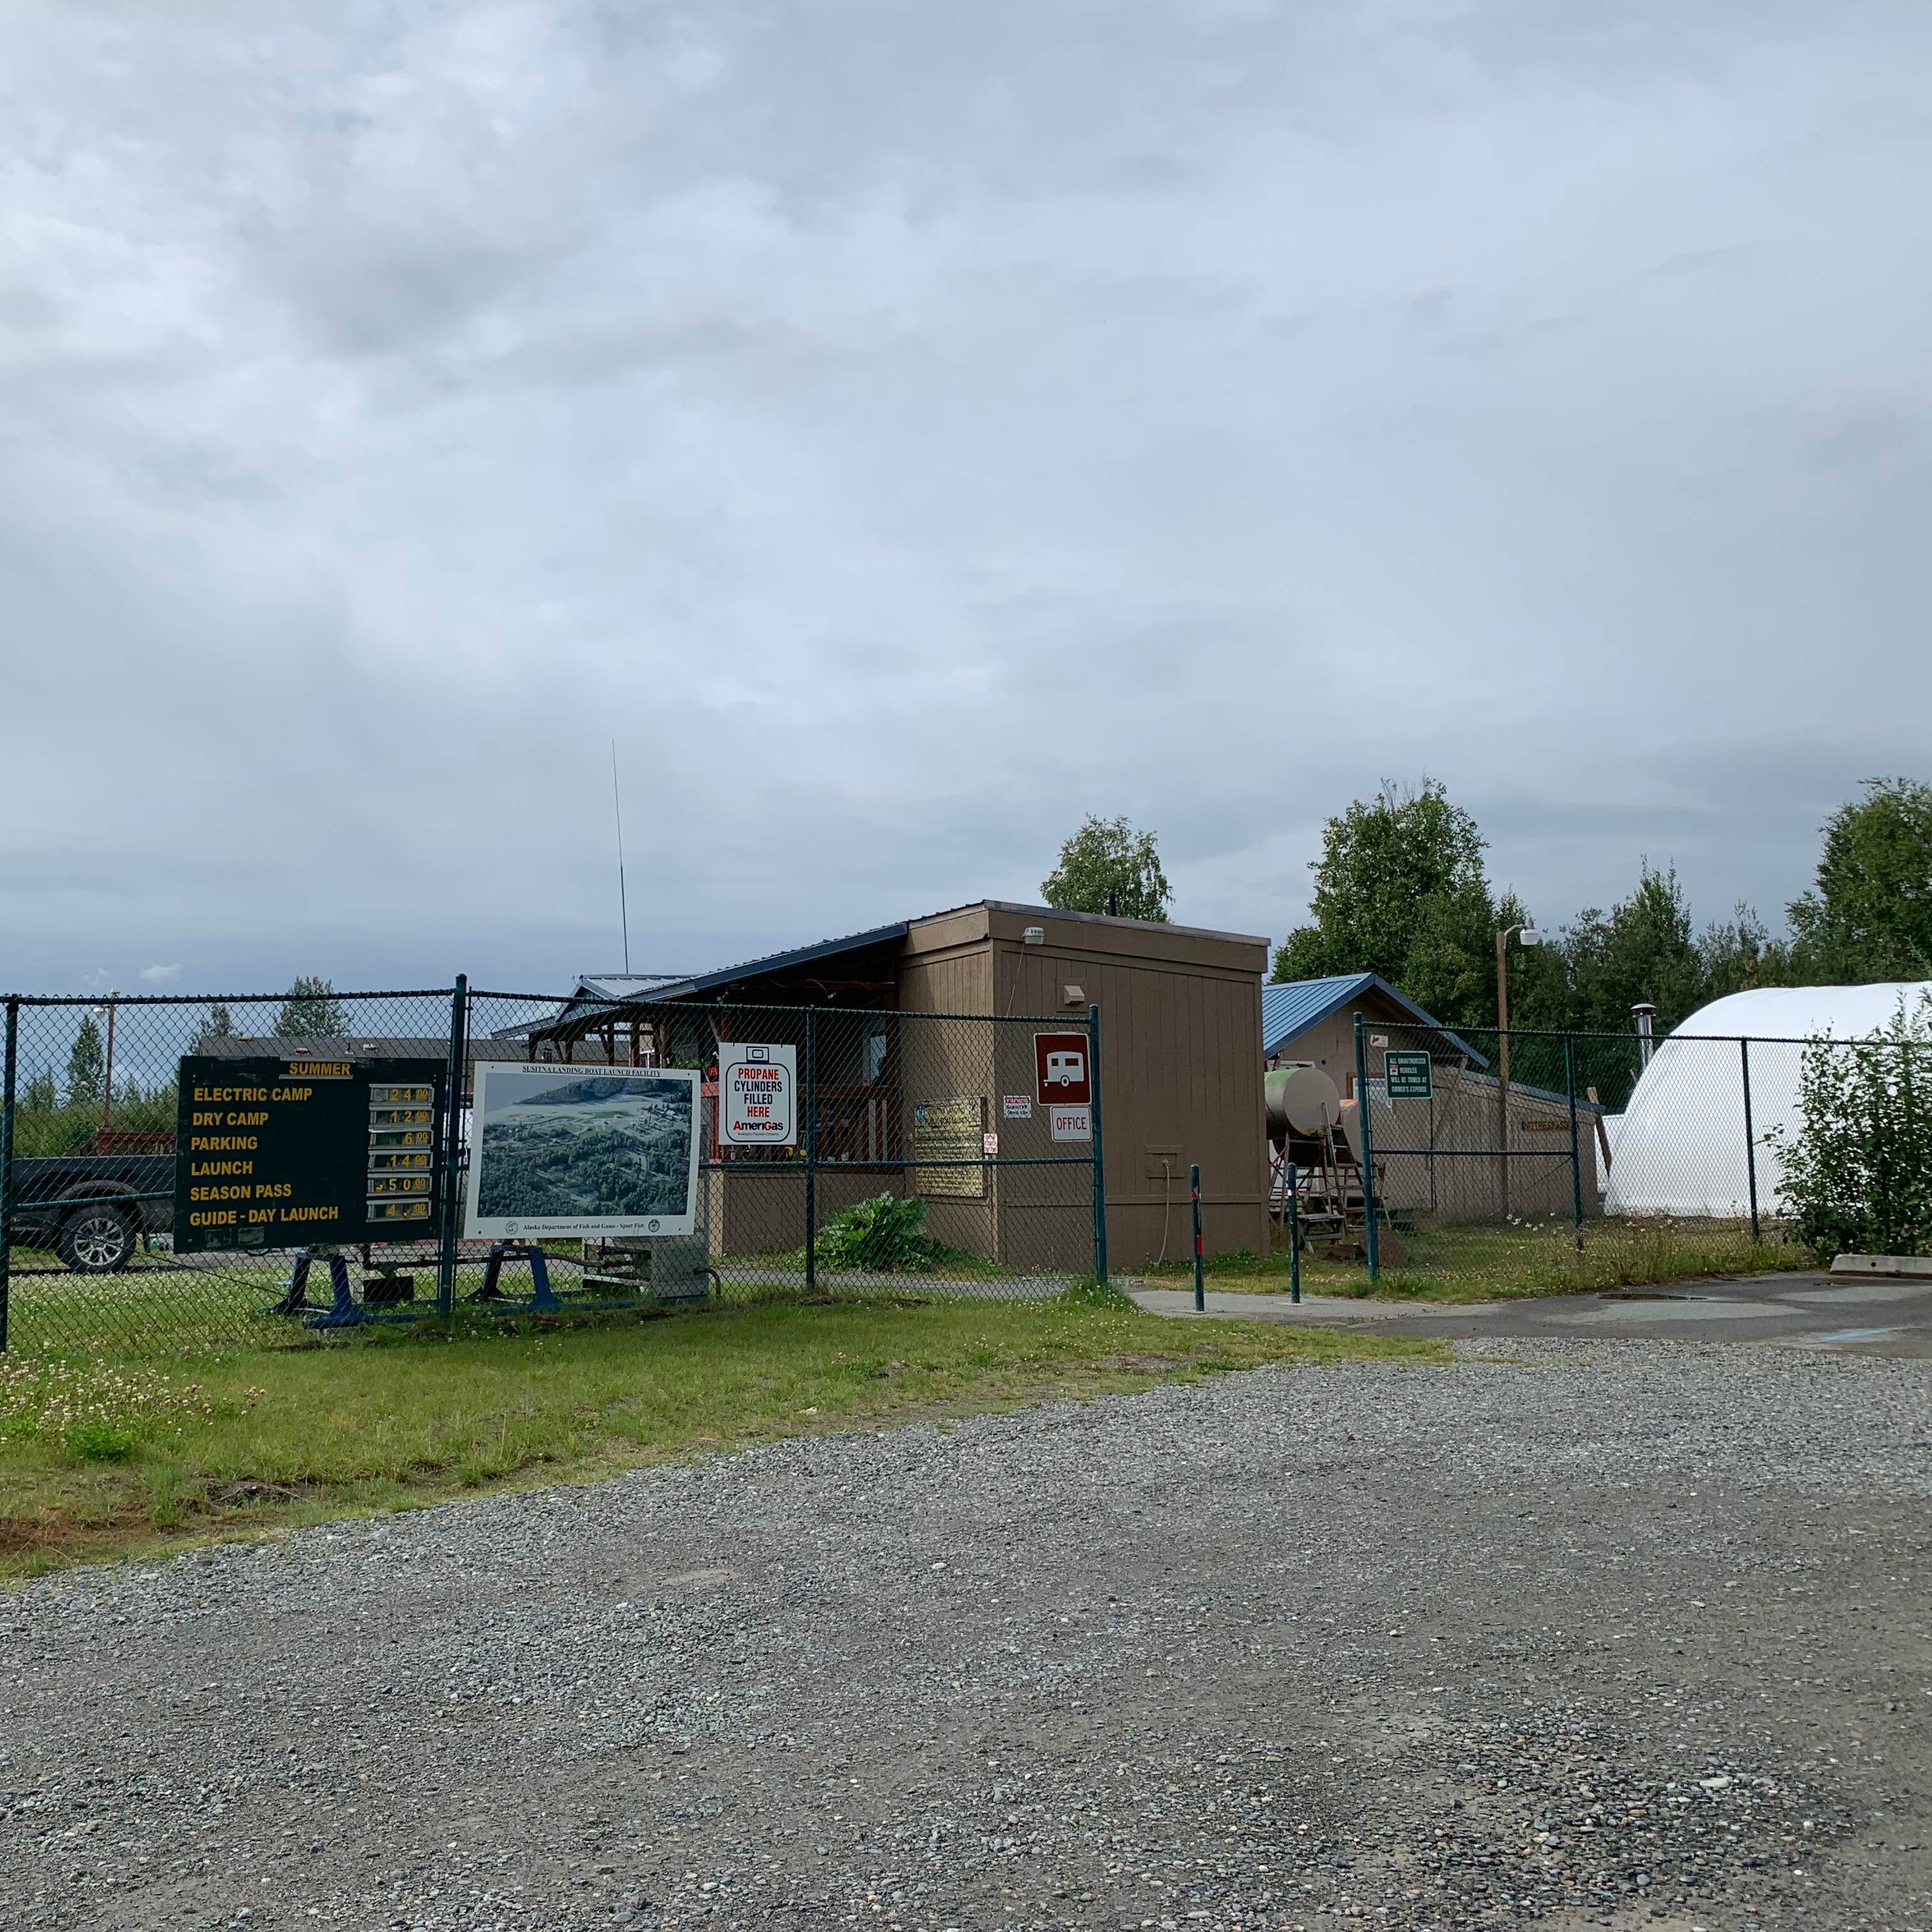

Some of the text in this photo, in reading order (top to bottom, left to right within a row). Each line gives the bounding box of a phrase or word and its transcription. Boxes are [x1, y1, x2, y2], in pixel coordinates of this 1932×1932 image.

[289, 1062, 351, 1075] SUMMER
[739, 1068, 779, 1080] PROPANE
[734, 1080, 783, 1092] CYLINDERS
[194, 1087, 312, 1101] ELECTRIC CAMP
[744, 1094, 772, 1105] FILLED
[747, 1107, 770, 1117] HERE
[193, 1112, 269, 1126] DRY CAMP
[733, 1121, 783, 1130] AmeriGas
[1057, 1117, 1087, 1130] OFFICE
[191, 1136, 258, 1151] PARKING
[191, 1161, 253, 1176] LAUNCH
[190, 1183, 292, 1200] SEASON PASS
[190, 1211, 237, 1226] GUIDE
[248, 1209, 277, 1223] DAY
[280, 1206, 339, 1222] LAUNCH
